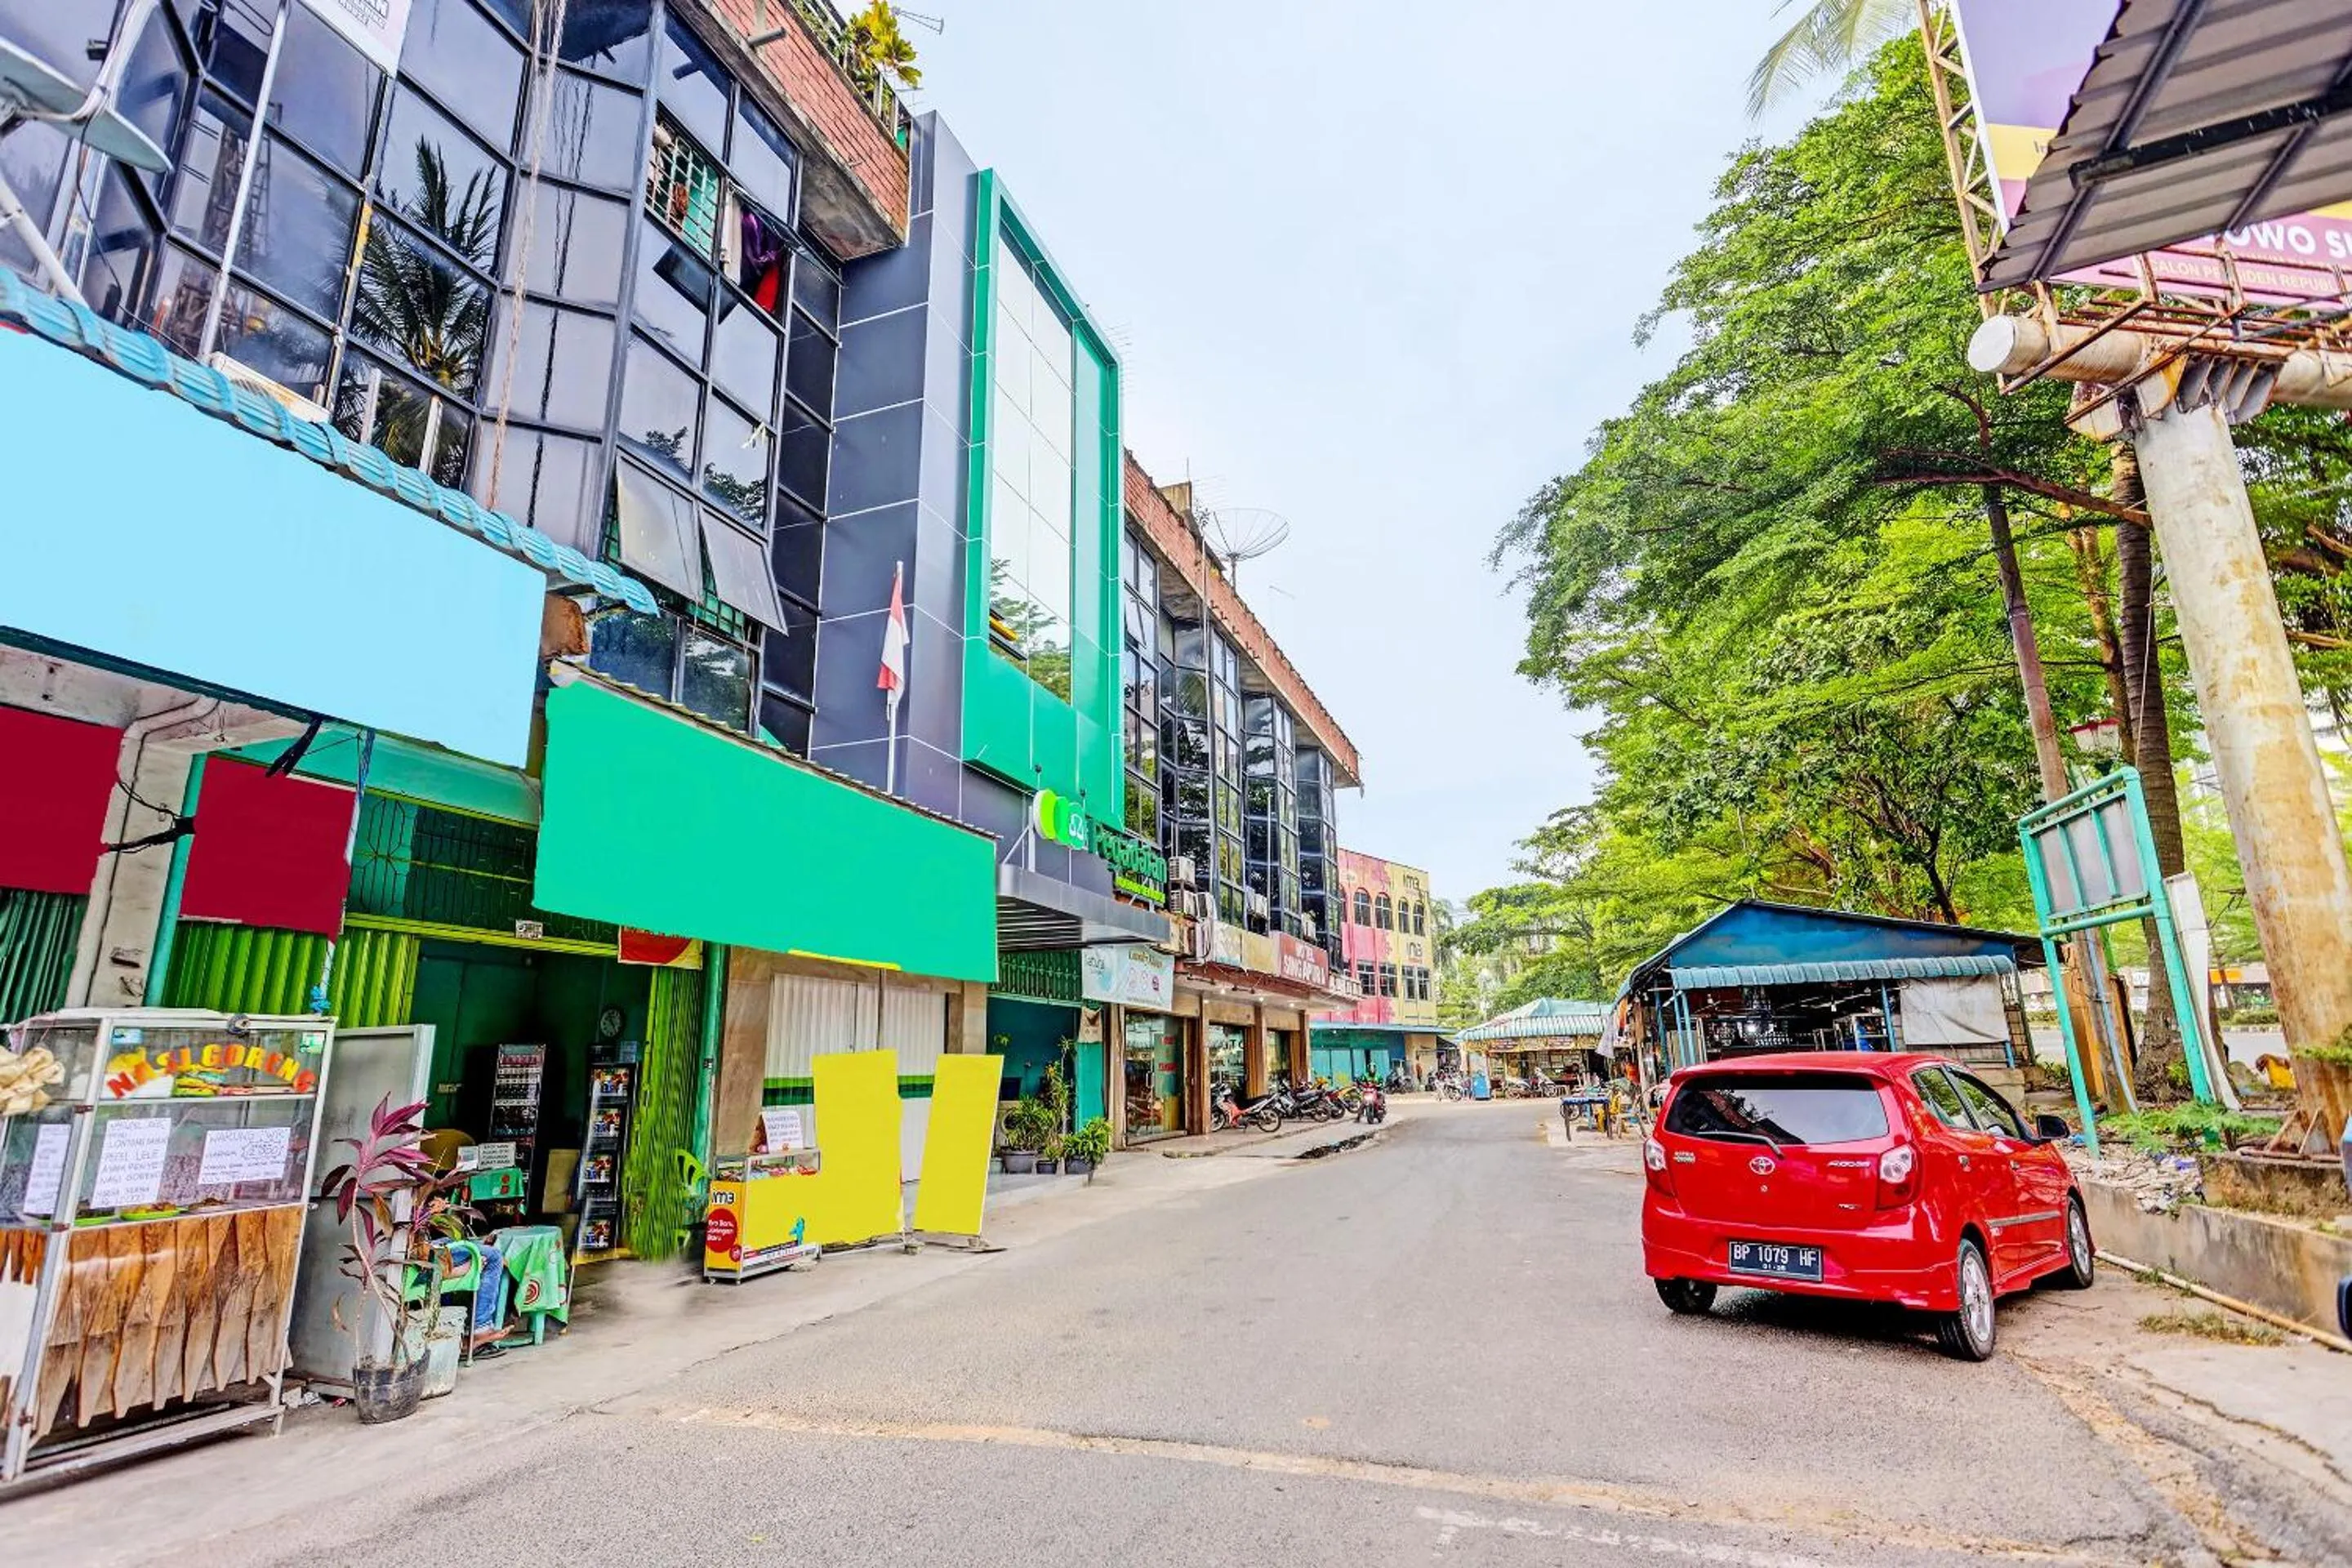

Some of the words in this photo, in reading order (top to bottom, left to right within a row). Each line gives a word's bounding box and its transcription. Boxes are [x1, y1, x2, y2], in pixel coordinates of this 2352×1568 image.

[107, 1045, 191, 1099] NASI
[202, 1044, 316, 1093] GORENG
[1734, 1245, 1750, 1261] BP
[1757, 1246, 1788, 1264] 1079
[1799, 1249, 1816, 1267] HF
